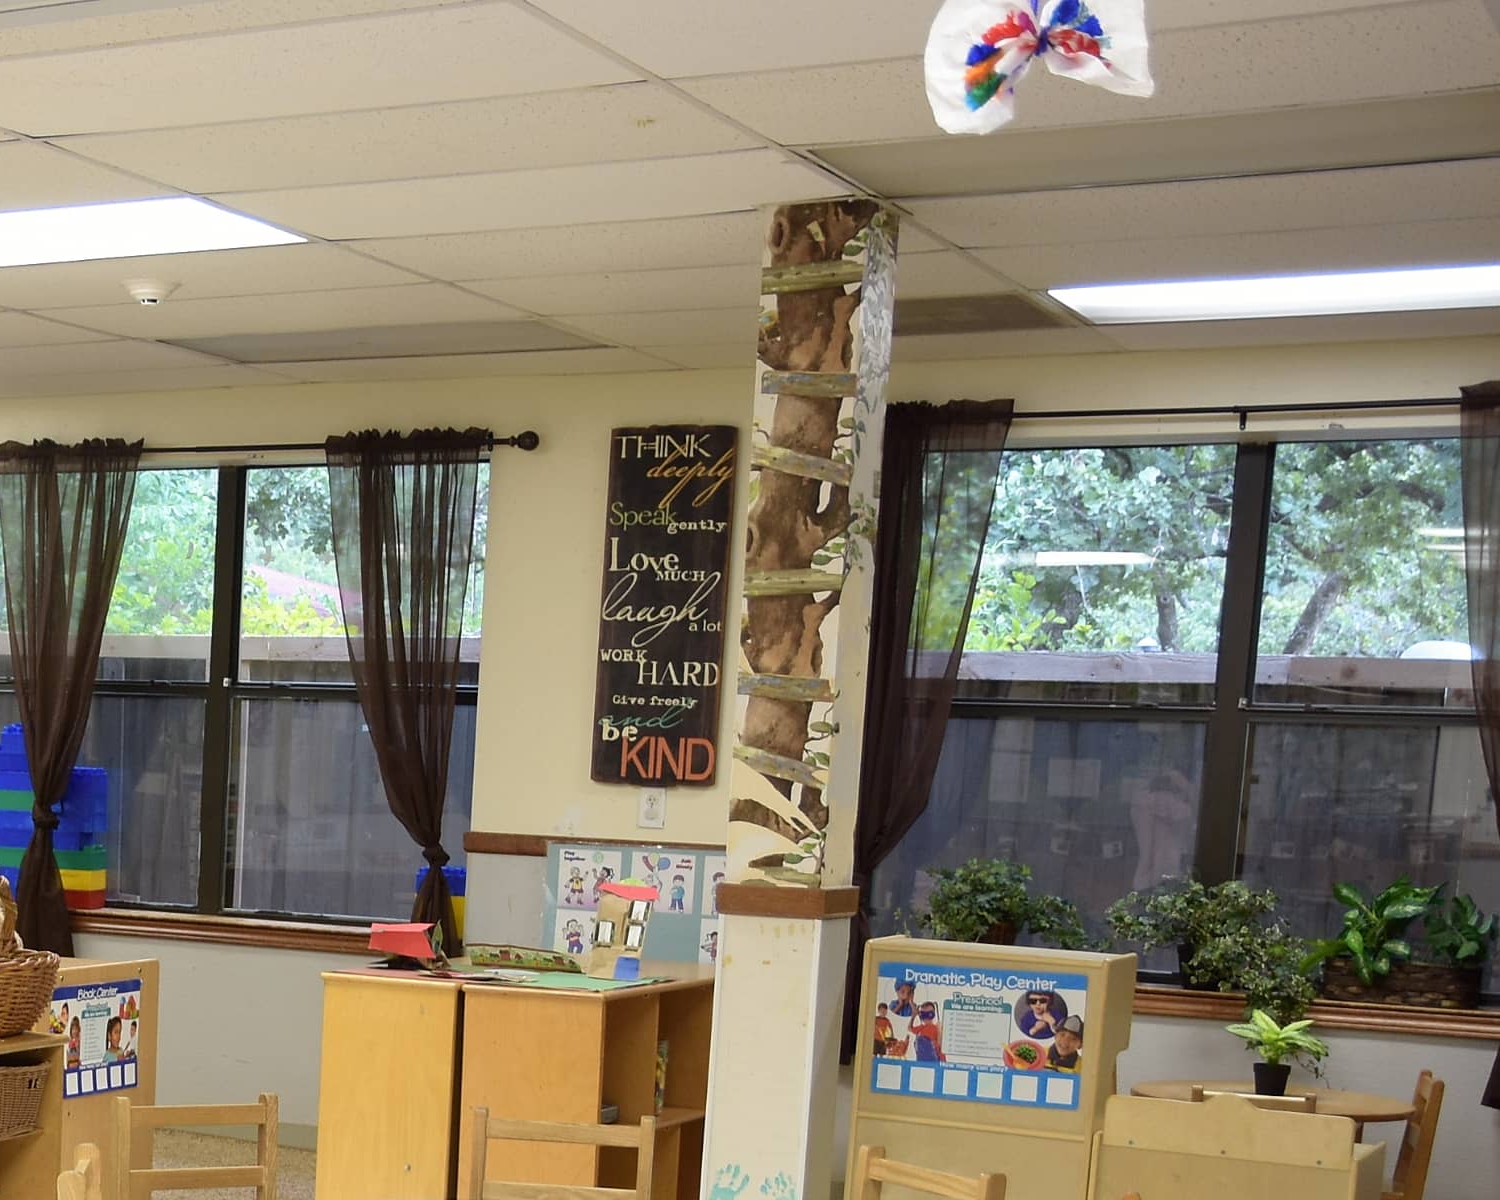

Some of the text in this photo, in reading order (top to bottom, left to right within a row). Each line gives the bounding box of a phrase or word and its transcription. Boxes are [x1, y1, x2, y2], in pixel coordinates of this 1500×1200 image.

[614, 434, 712, 459] THINK
[646, 446, 734, 509] deeply
[610, 502, 676, 531] Speak
[667, 519, 726, 534] gently
[609, 537, 680, 571] Love
[655, 570, 706, 582] MUCH
[602, 572, 721, 648] laugh
[688, 620, 722, 632] a lot
[600, 649, 648, 662] WORK
[637, 661, 719, 687] HARD
[612, 695, 698, 709] Give freely
[598, 700, 691, 729] and
[602, 718, 638, 741] be
[620, 736, 715, 781] KIND
[905, 968, 1057, 991] Dramatic Play Center
[953, 992, 1003, 1008] Preschool
